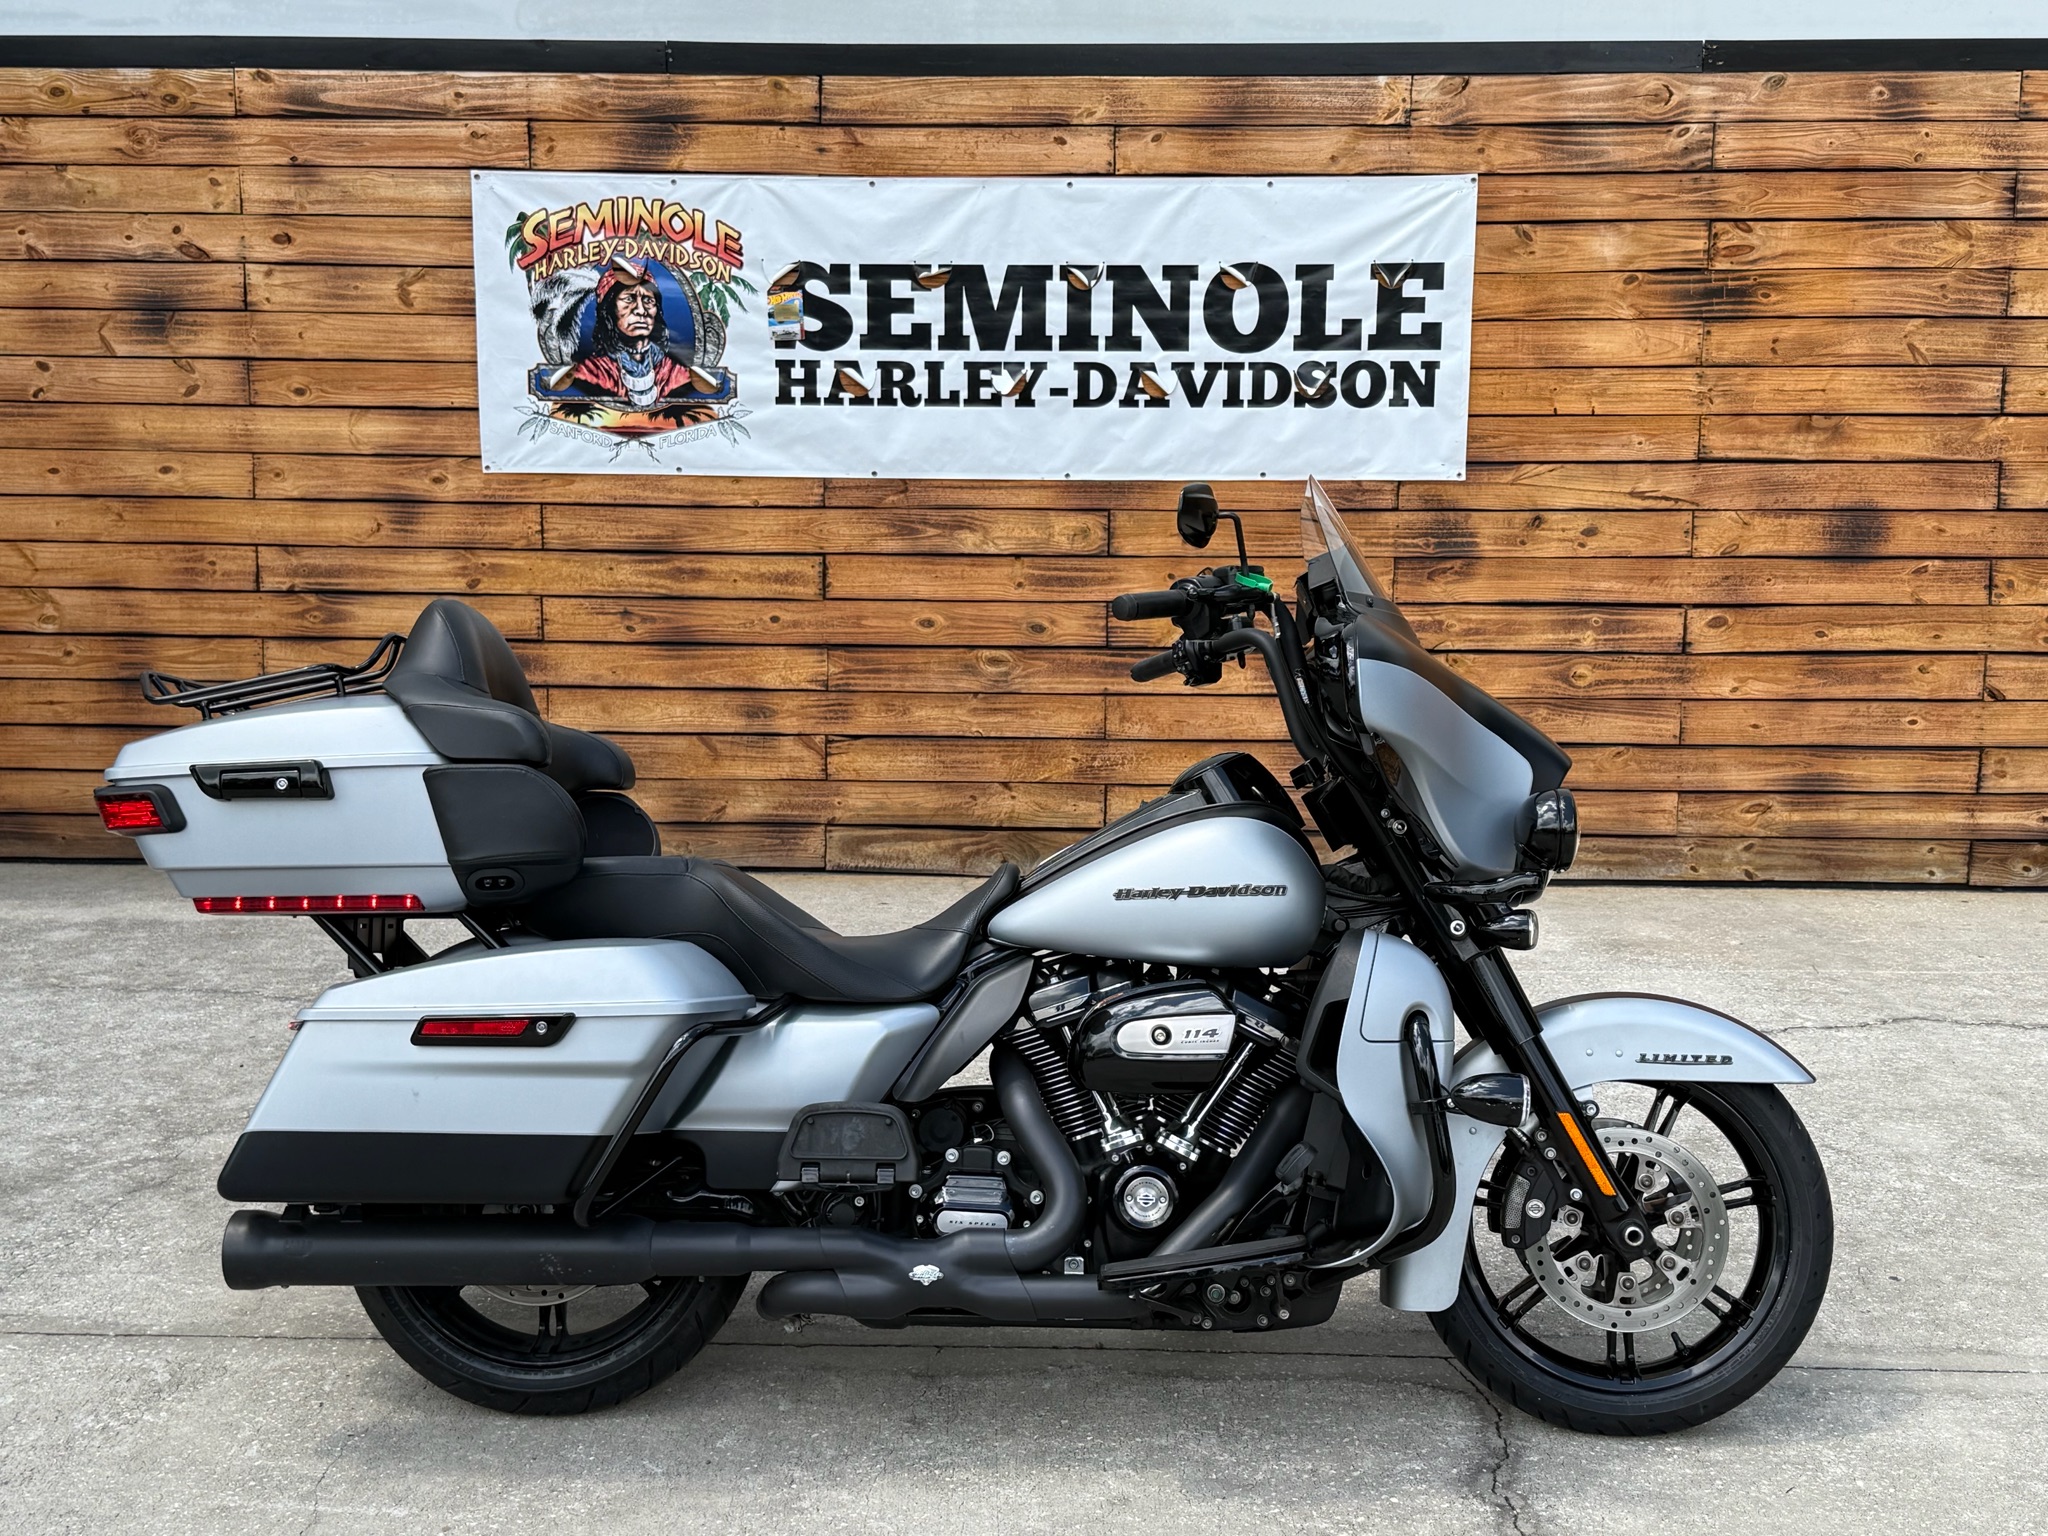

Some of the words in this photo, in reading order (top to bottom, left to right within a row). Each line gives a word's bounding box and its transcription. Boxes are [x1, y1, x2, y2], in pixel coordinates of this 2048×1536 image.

[517, 197, 743, 270] SEMINOLE
[534, 238, 732, 284] HARLEY-DAVIDSON
[775, 261, 1445, 354] SEMINOLE
[775, 359, 1441, 409] HARLEY-DAVIDSON
[659, 425, 718, 449] FLORIDA
[1113, 884, 1289, 901] Harley-Davidson
[1184, 1028, 1219, 1039] 114
[1639, 1053, 1733, 1065] LIMITED
